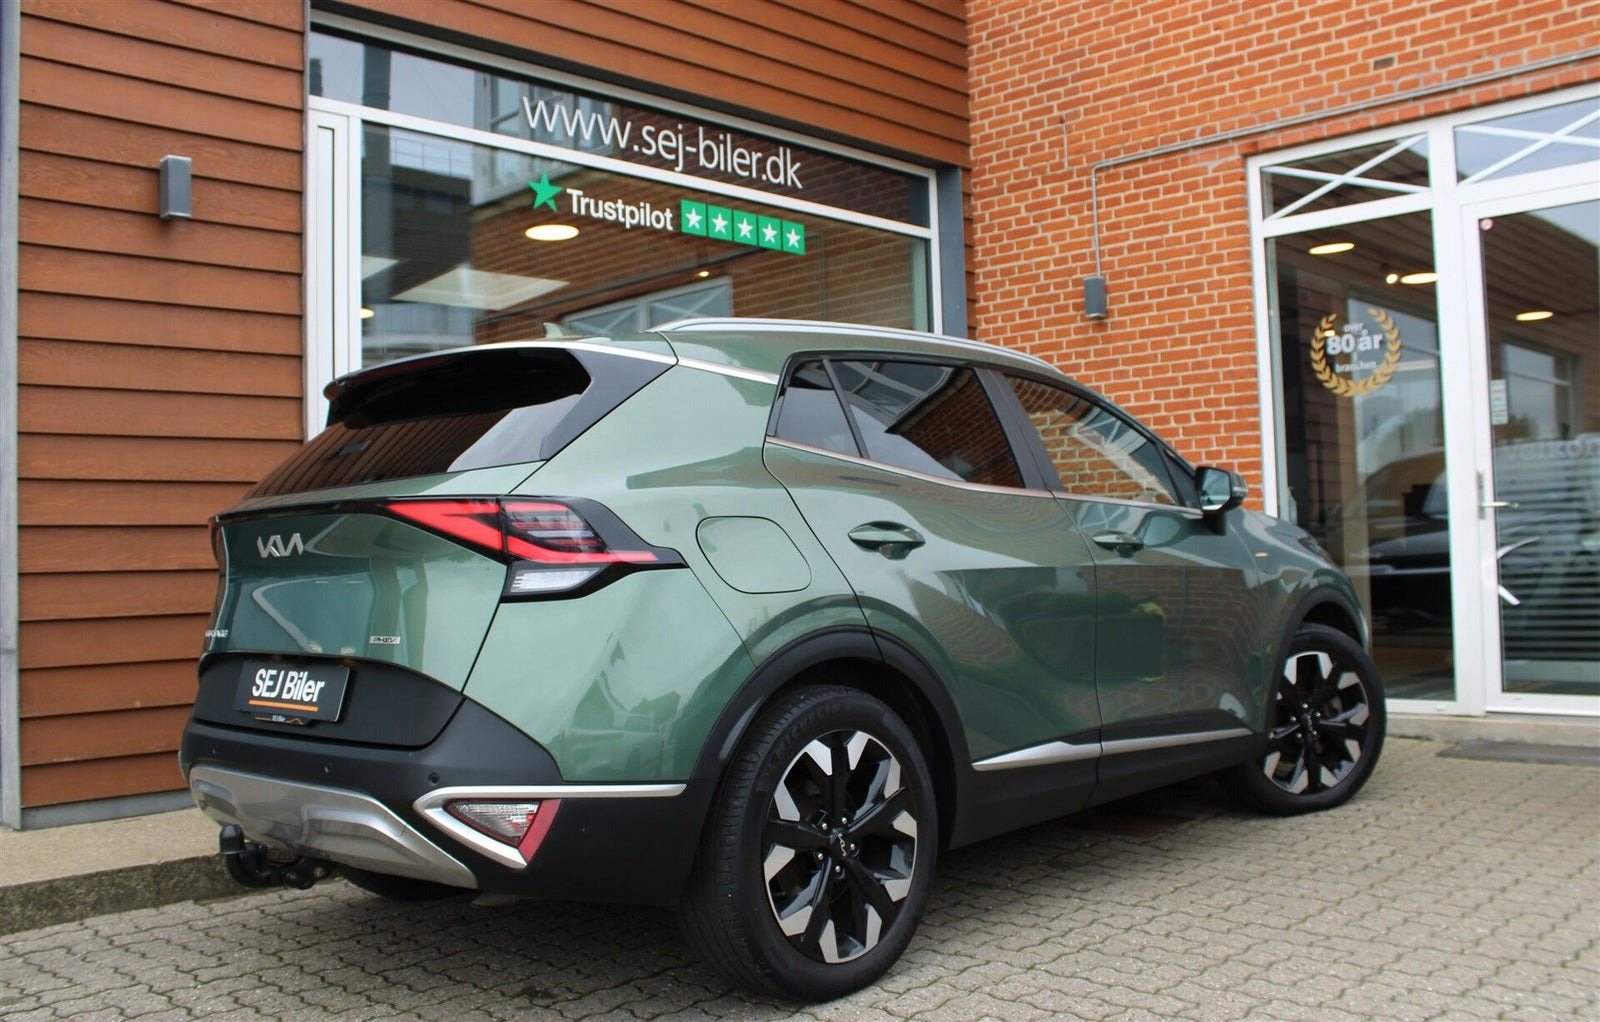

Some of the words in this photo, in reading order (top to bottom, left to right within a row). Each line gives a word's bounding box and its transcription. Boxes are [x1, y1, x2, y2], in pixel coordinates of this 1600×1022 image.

[522, 95, 803, 190] www.sej-biler.dk
[566, 187, 674, 231] Trustpilot
[1326, 333, 1355, 355] 80
[1358, 328, 1383, 351] år
[256, 533, 304, 558] KIA
[251, 668, 282, 698] SEJ
[281, 670, 326, 702] Biler
